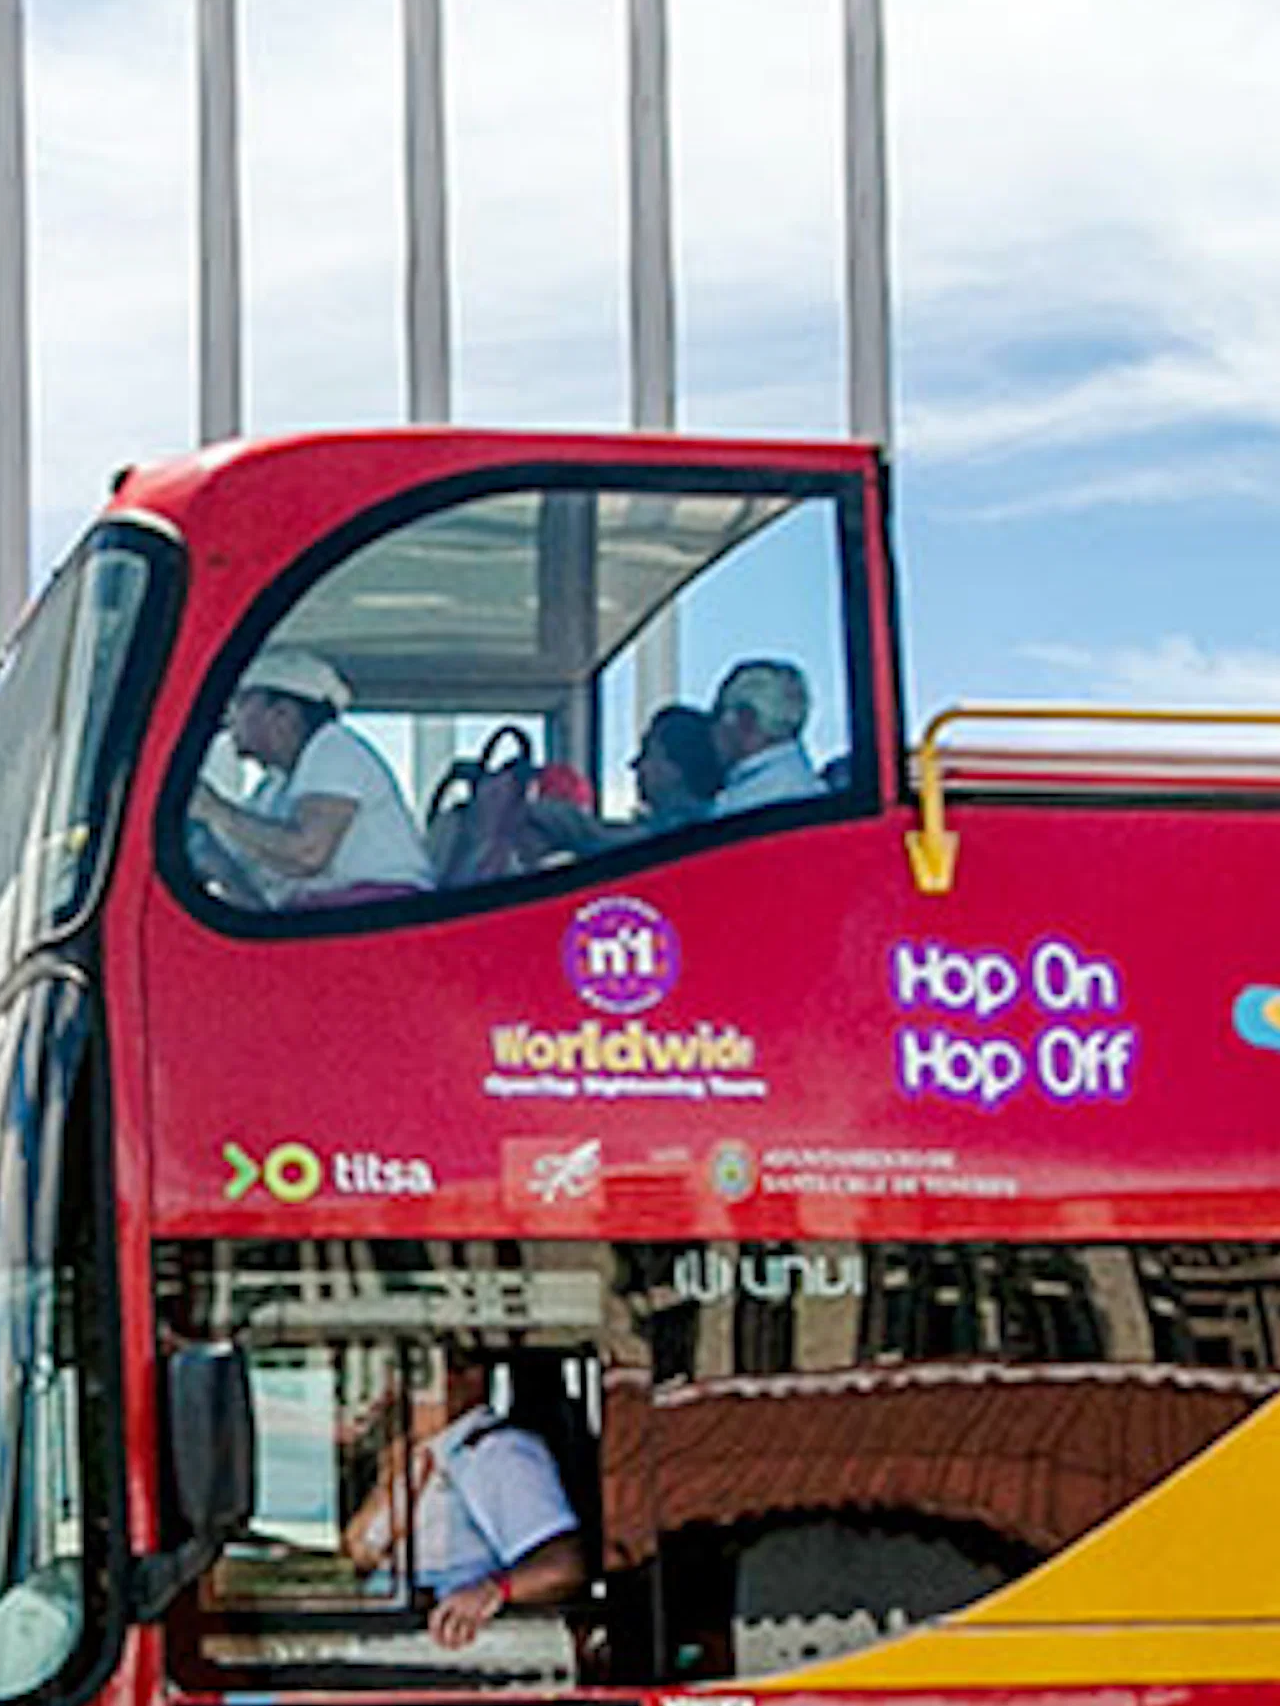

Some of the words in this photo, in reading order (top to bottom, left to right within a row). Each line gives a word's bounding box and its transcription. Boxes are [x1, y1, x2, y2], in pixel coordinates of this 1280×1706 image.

[895, 943, 1019, 1015] Hop
[1032, 941, 1118, 1010] On
[900, 1029, 1023, 1102] Hop
[1036, 1025, 1135, 1097] Off
[333, 1151, 437, 1194] titsa
